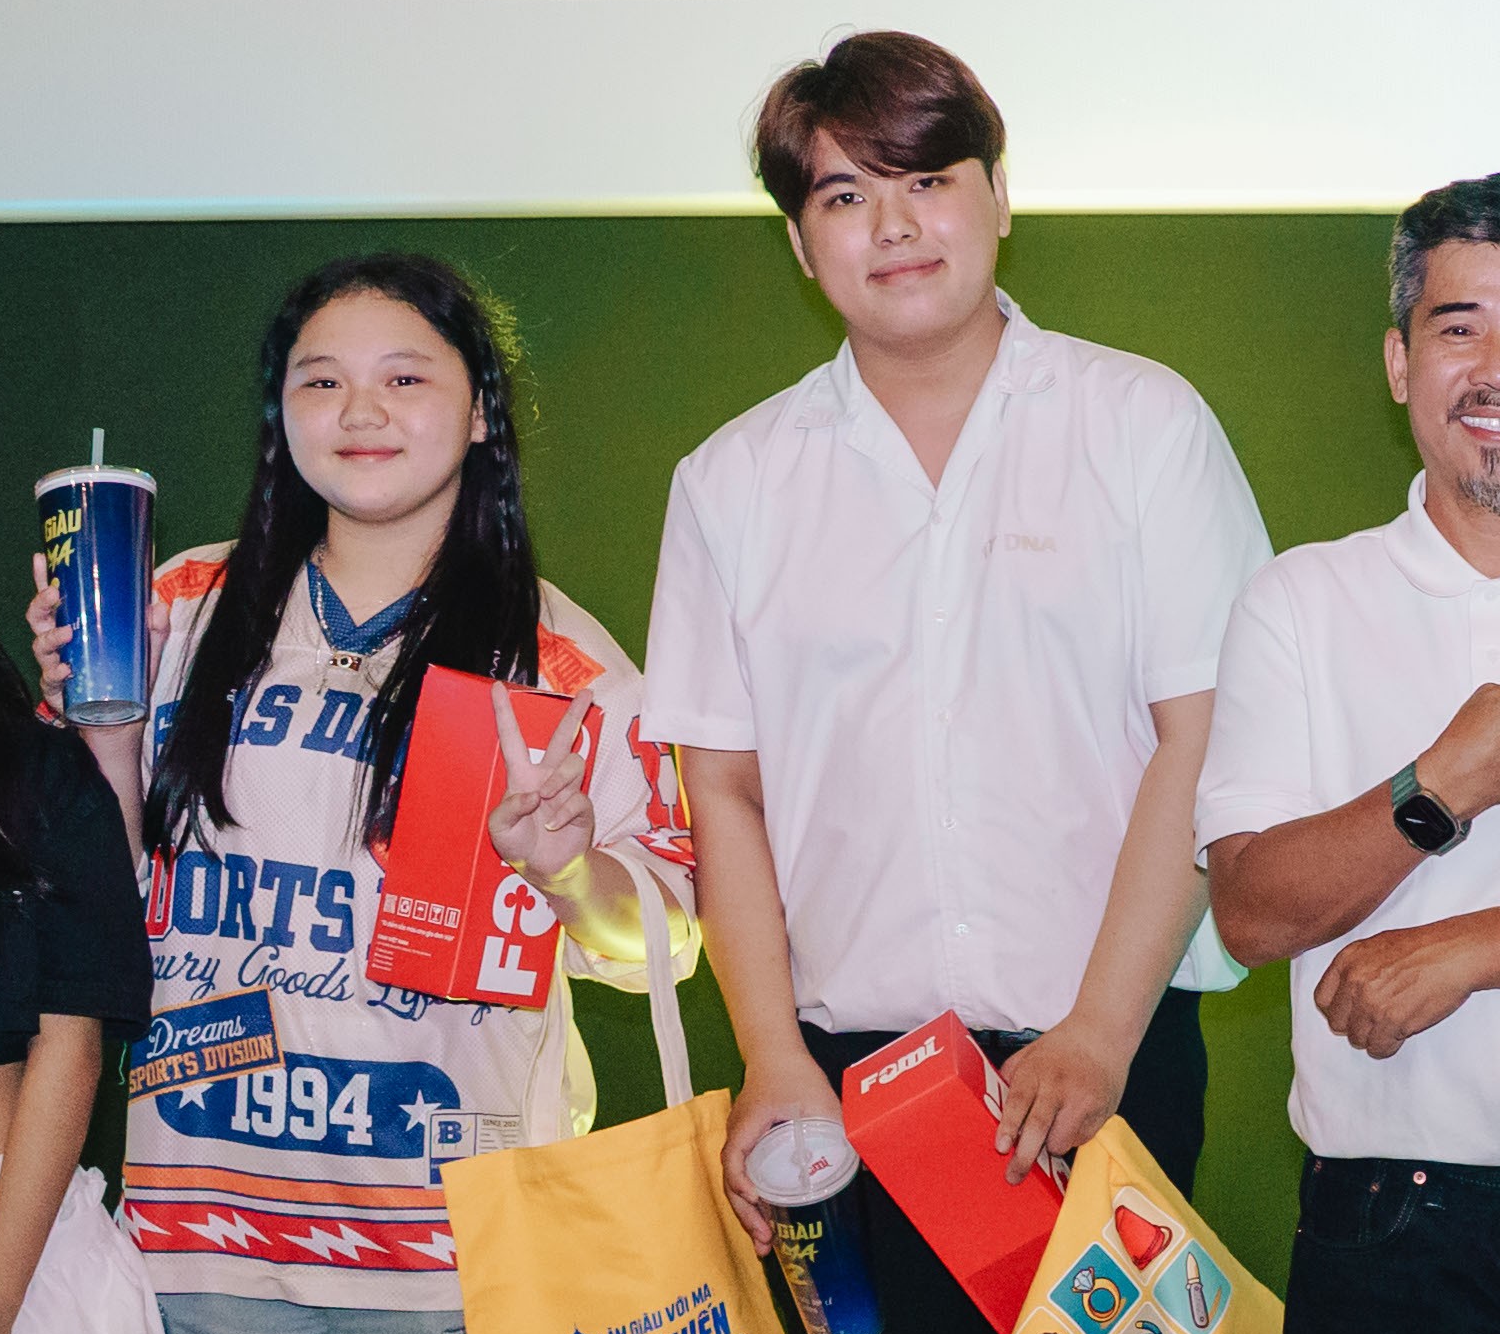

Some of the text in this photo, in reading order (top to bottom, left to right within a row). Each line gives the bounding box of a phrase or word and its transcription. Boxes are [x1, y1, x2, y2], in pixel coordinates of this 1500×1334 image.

[238, 943, 356, 1003] Goods
[145, 1013, 246, 1060] Dreams
[129, 1050, 199, 1094] SPORTS
[231, 1066, 374, 1147] 1994
